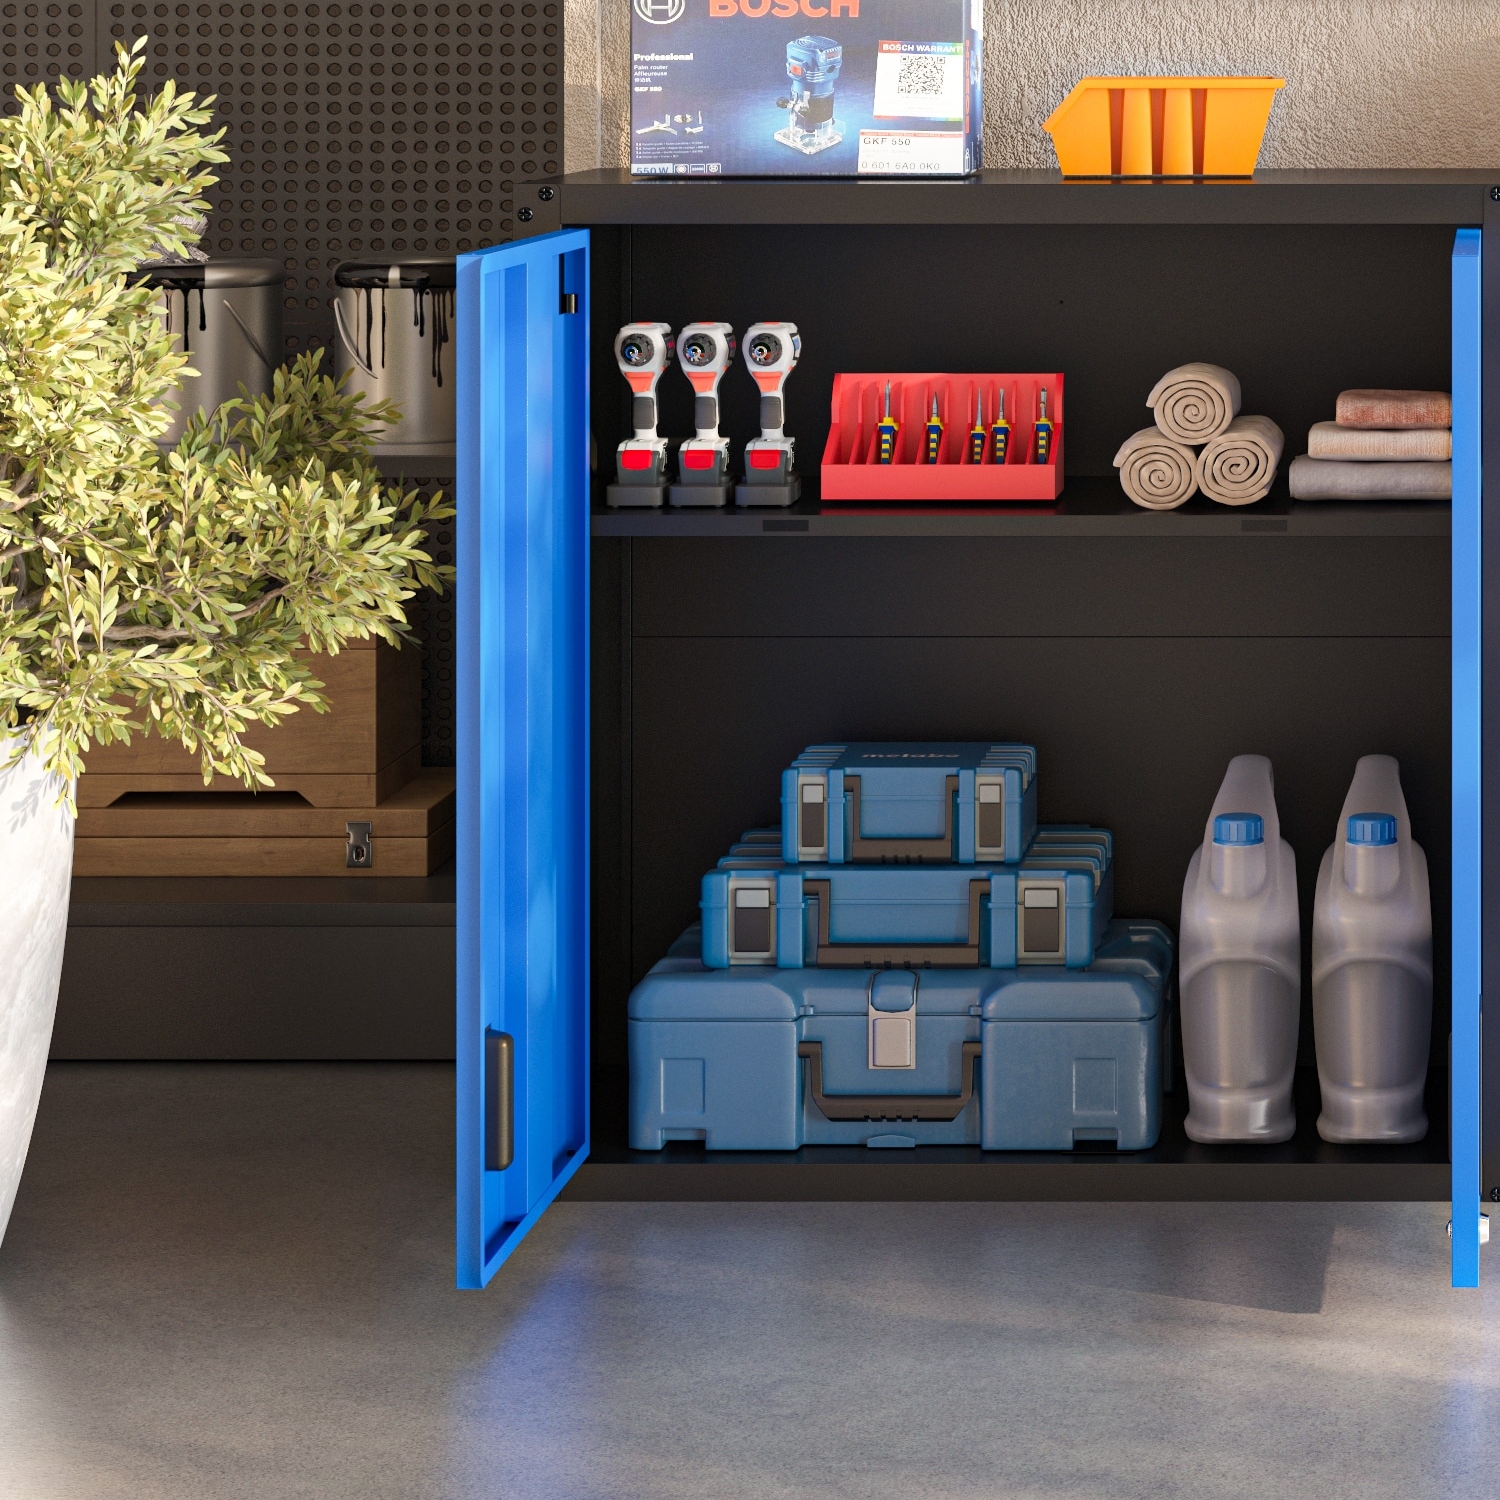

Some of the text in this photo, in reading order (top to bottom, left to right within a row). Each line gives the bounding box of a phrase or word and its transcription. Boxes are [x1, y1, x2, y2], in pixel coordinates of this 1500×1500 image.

[882, 43, 914, 52] BOSCH
[633, 52, 694, 62] Professional
[863, 136, 911, 146] GKF 550
[871, 161, 890, 169] 601
[636, 166, 669, 174] 550 W
